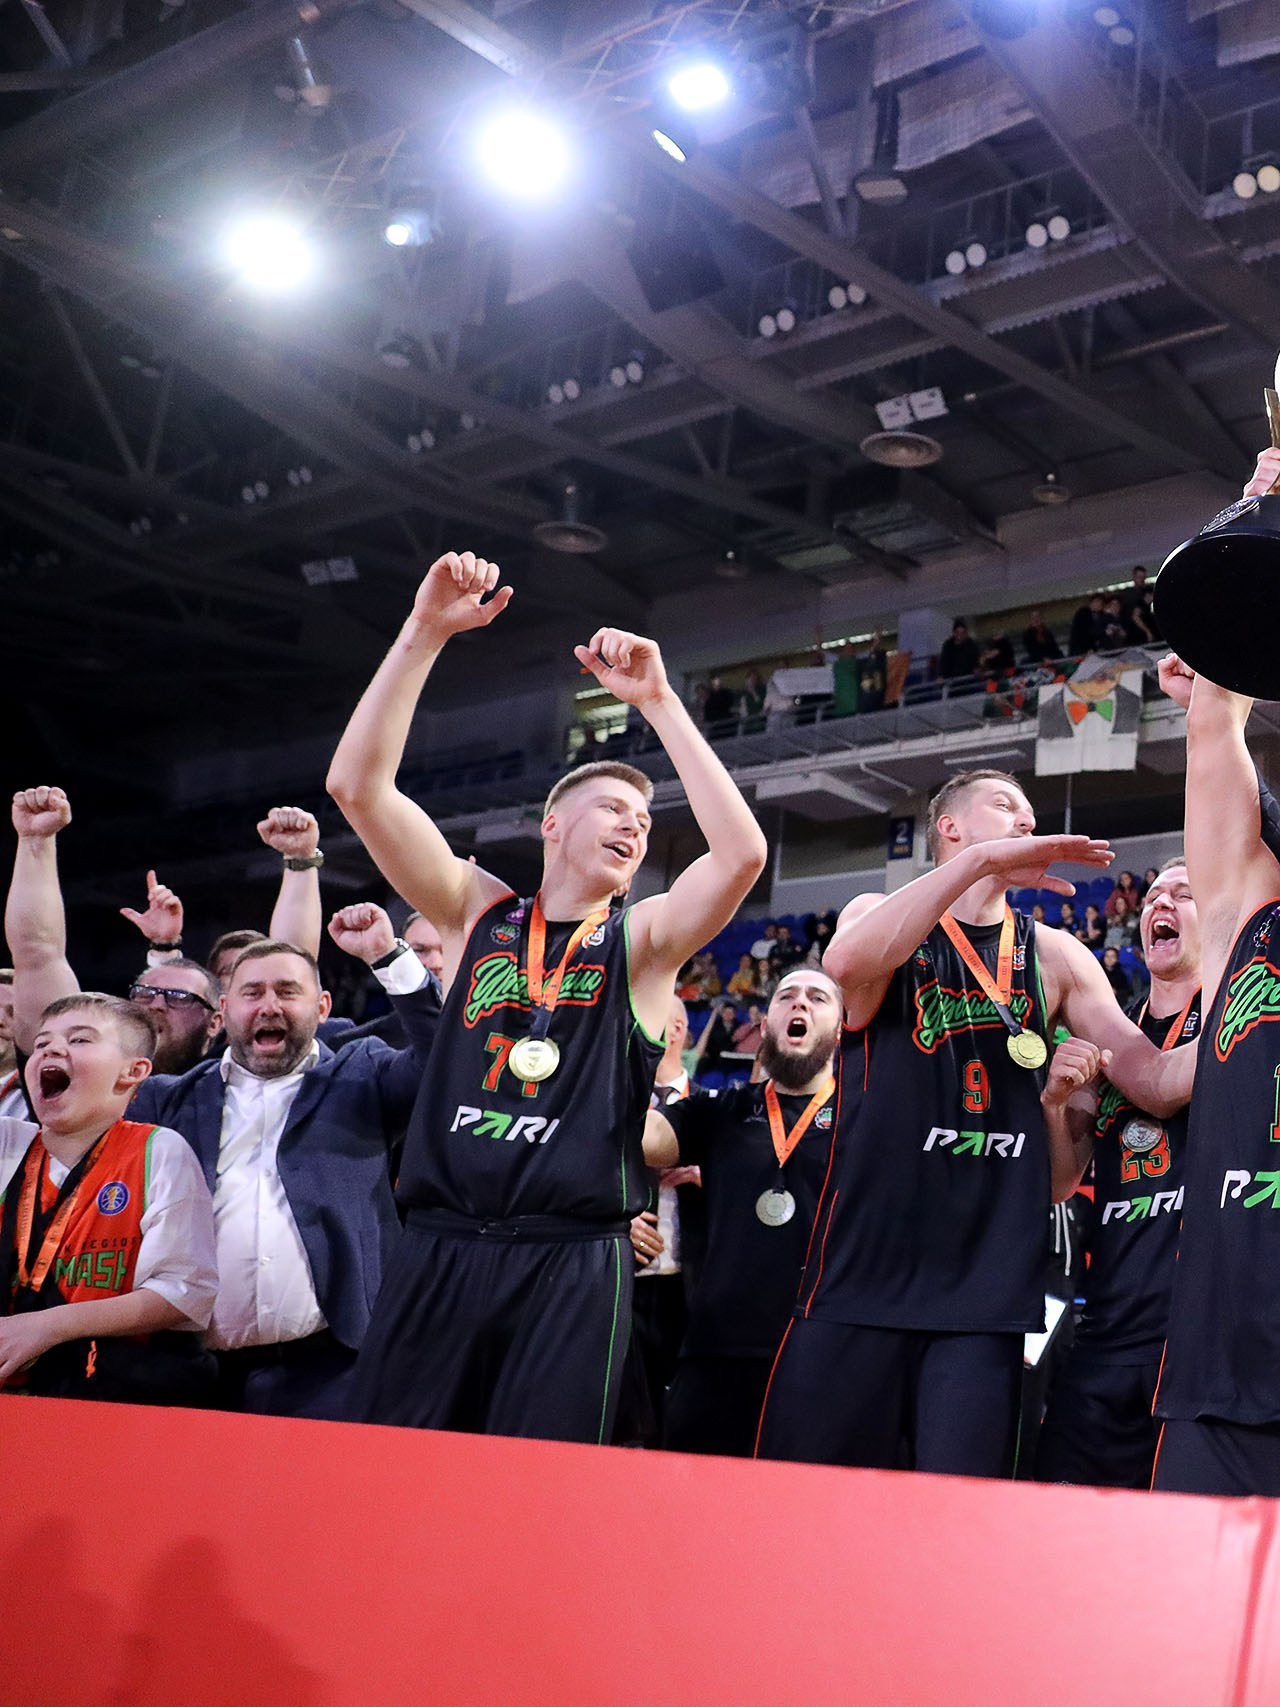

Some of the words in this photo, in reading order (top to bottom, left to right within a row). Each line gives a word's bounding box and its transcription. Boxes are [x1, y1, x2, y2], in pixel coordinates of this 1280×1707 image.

[963, 1060, 991, 1114] 9
[449, 1105, 560, 1144] PARI
[922, 1127, 1026, 1159] PARI
